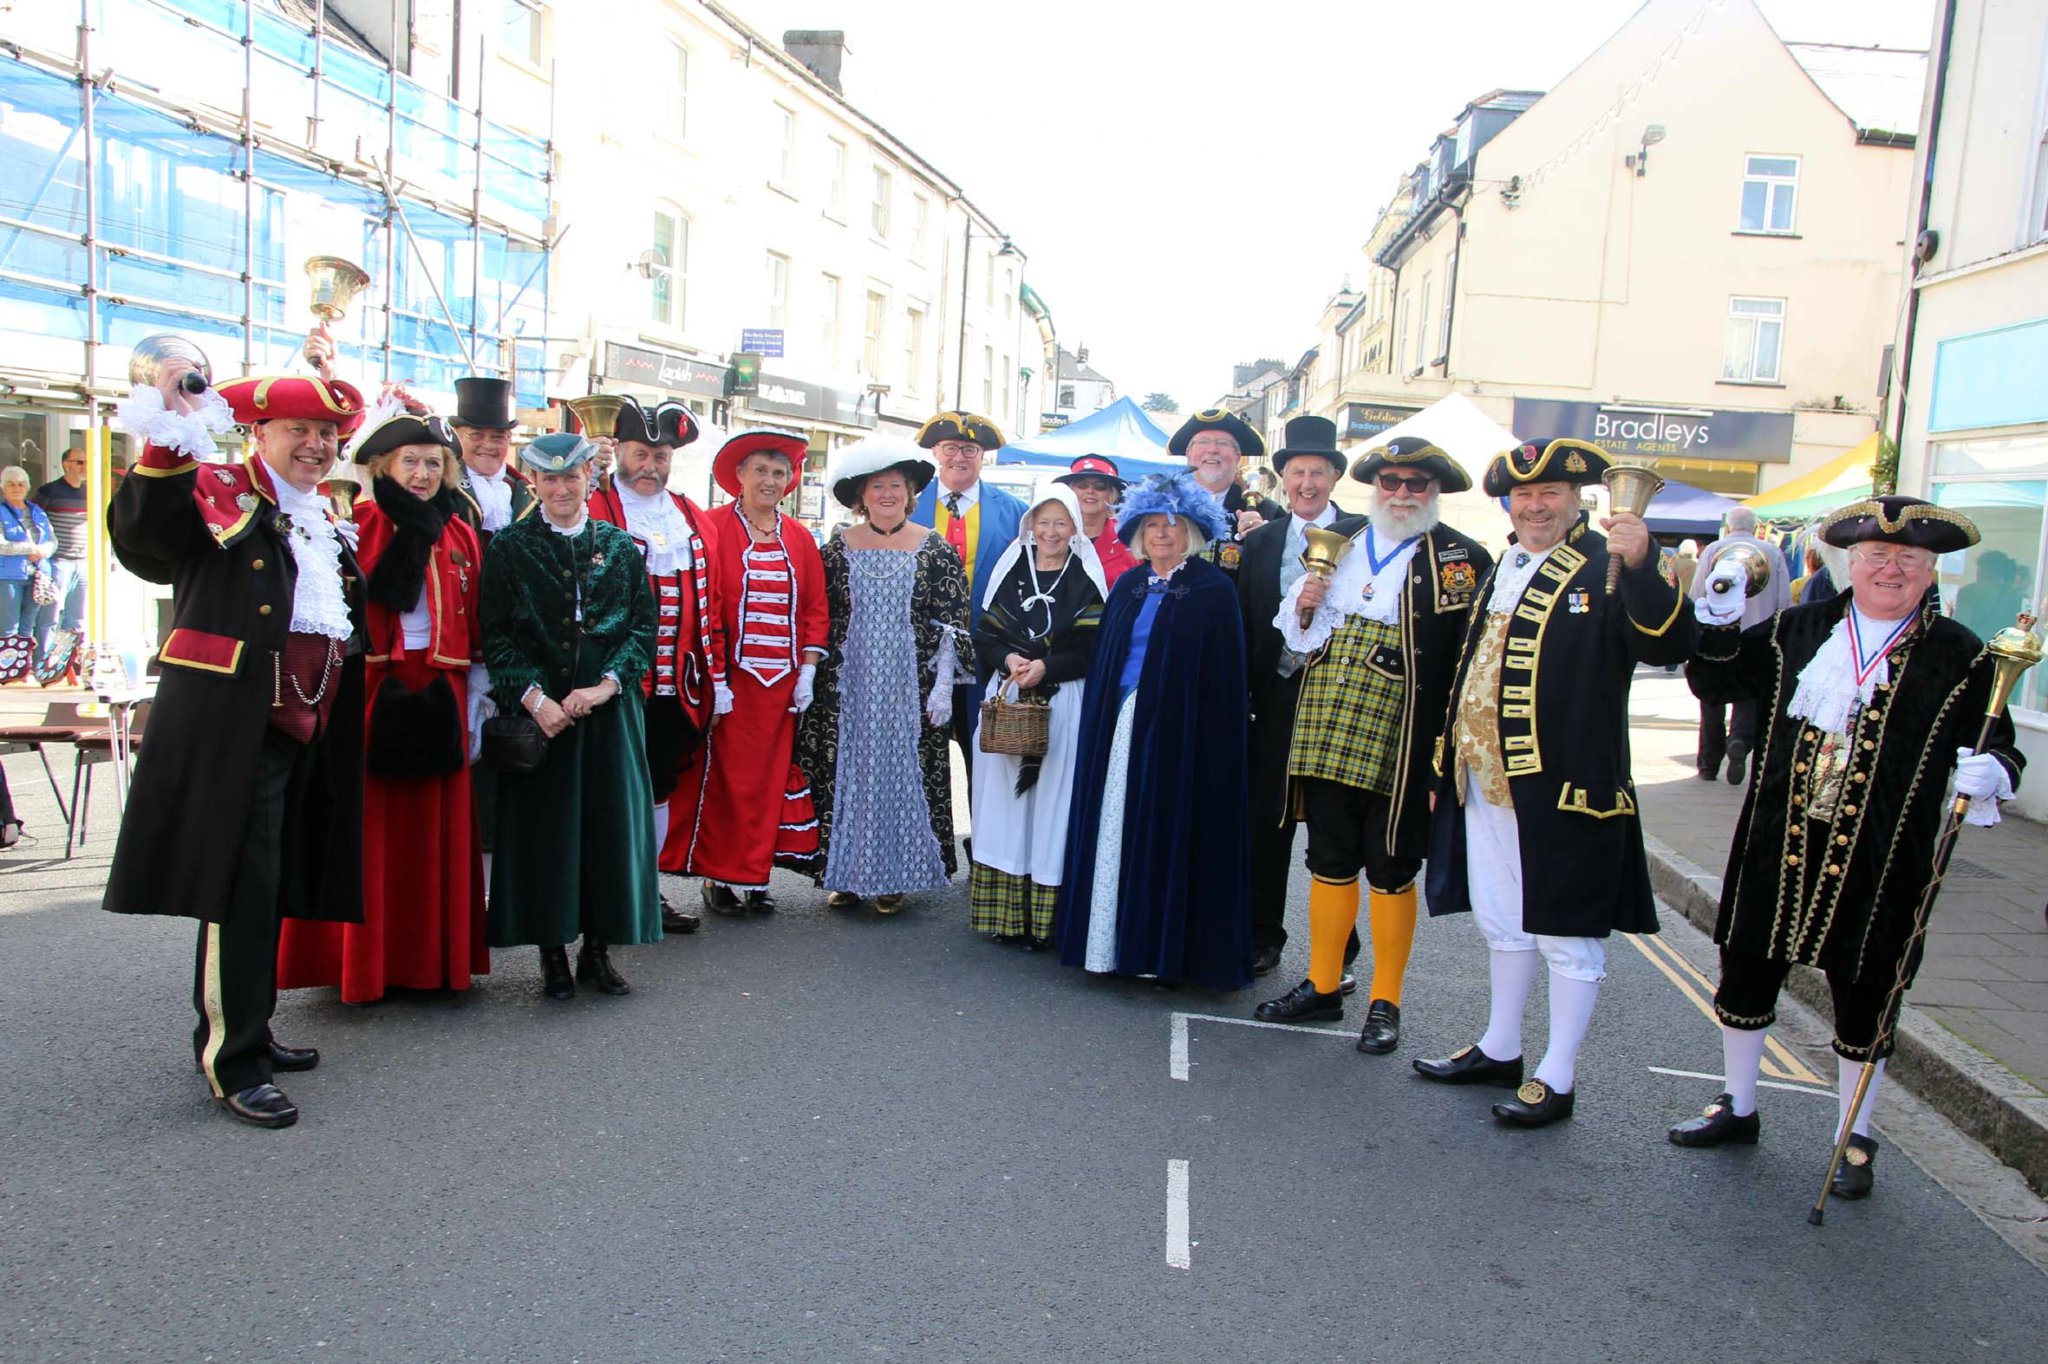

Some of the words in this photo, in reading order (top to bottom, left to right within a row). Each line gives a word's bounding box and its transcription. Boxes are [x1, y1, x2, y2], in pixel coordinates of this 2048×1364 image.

[1594, 413, 1709, 449] Bradleys
[1594, 439, 1629, 450] ESTATE
[1636, 441, 1677, 452] AGENTS
